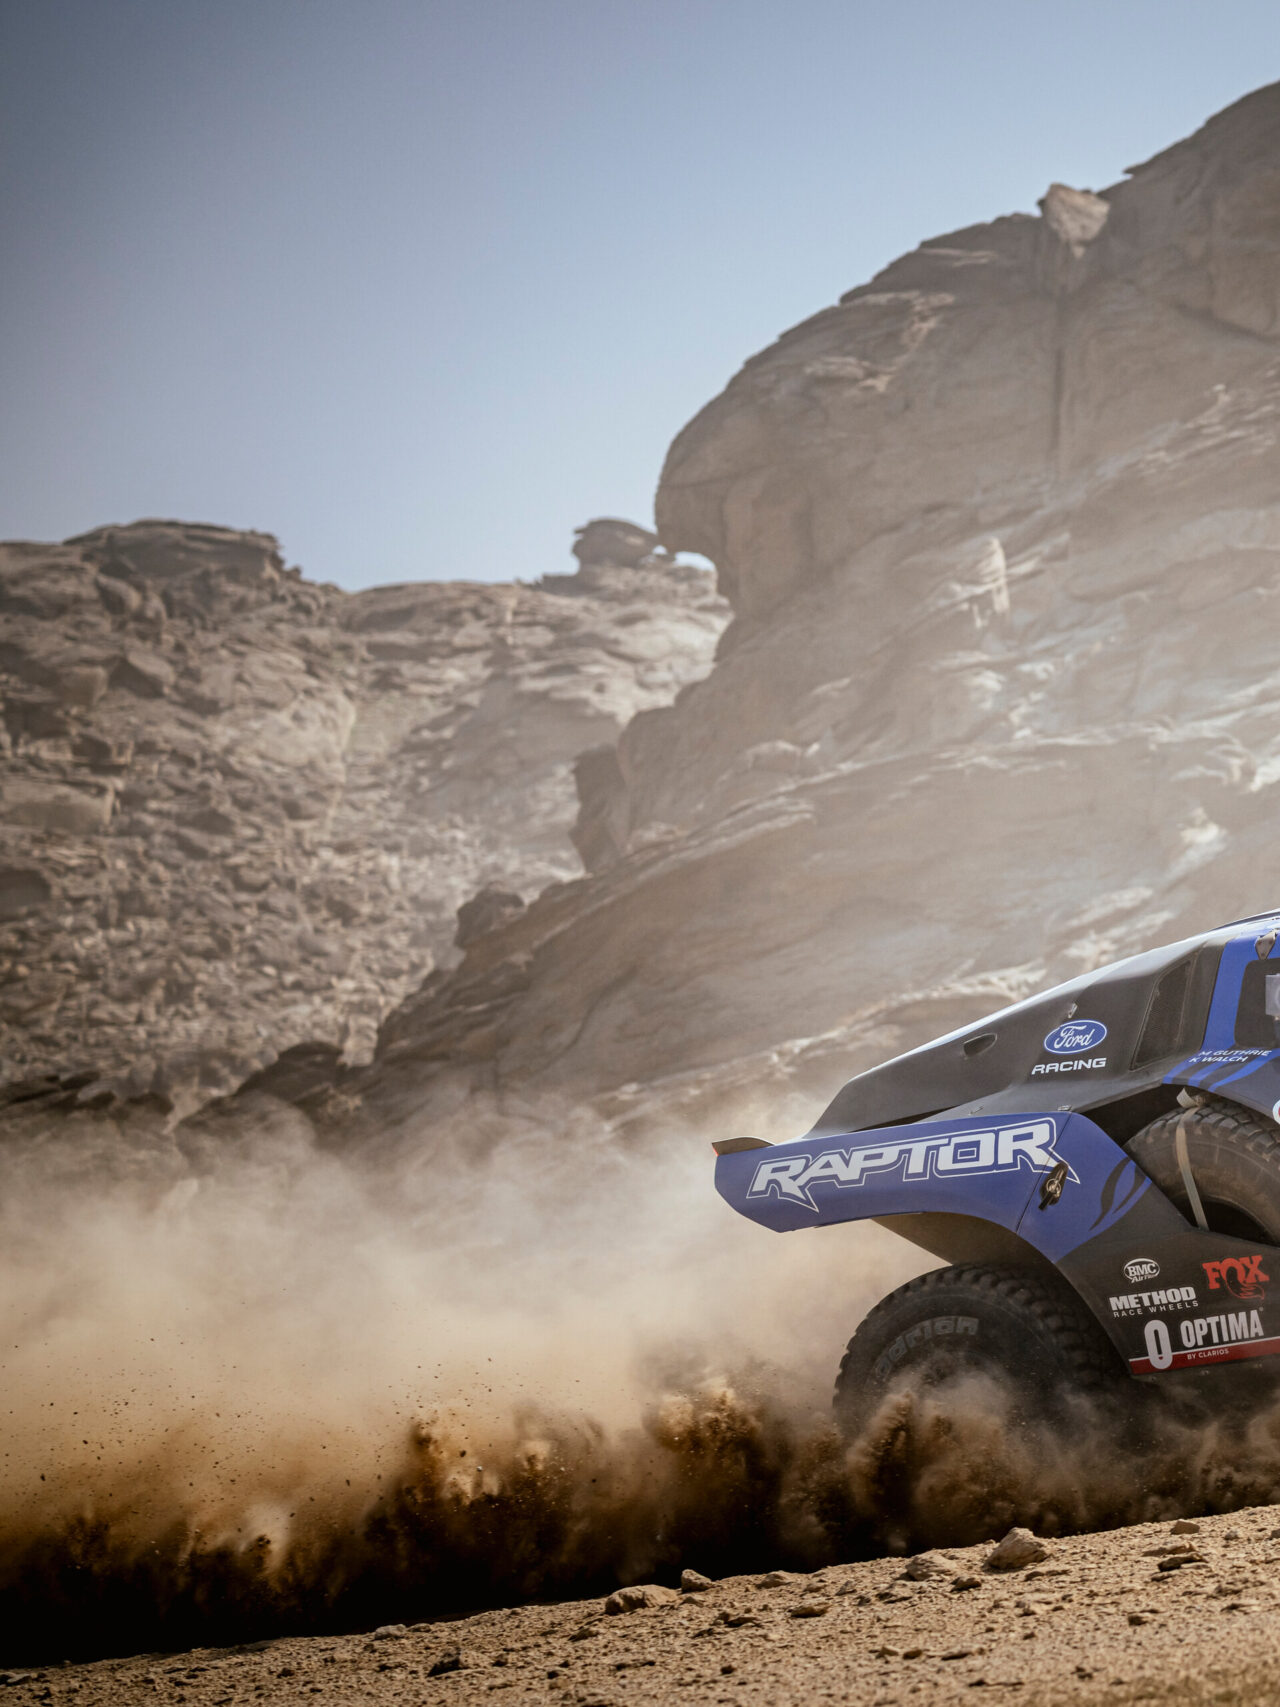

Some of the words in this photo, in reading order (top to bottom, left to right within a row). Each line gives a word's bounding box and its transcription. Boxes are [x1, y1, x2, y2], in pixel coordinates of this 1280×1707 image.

[1053, 1023, 1094, 1049] Ford
[1189, 1055, 1201, 1063] K
[1202, 1055, 1249, 1063] WALCH
[1214, 1049, 1272, 1057] GUTHRIE
[1031, 1057, 1107, 1075] RACING
[748, 1118, 1078, 1211] RAPTOR
[1126, 1263, 1157, 1277] BMC
[1202, 1254, 1270, 1292] FOX
[1109, 1286, 1196, 1311] METHOD
[1113, 1308, 1143, 1318] RACE
[1150, 1300, 1199, 1313] WHEELS
[1180, 1309, 1264, 1348] OPTIMA
[1187, 1352, 1196, 1360] BY
[1198, 1348, 1230, 1359] CLARIOS
